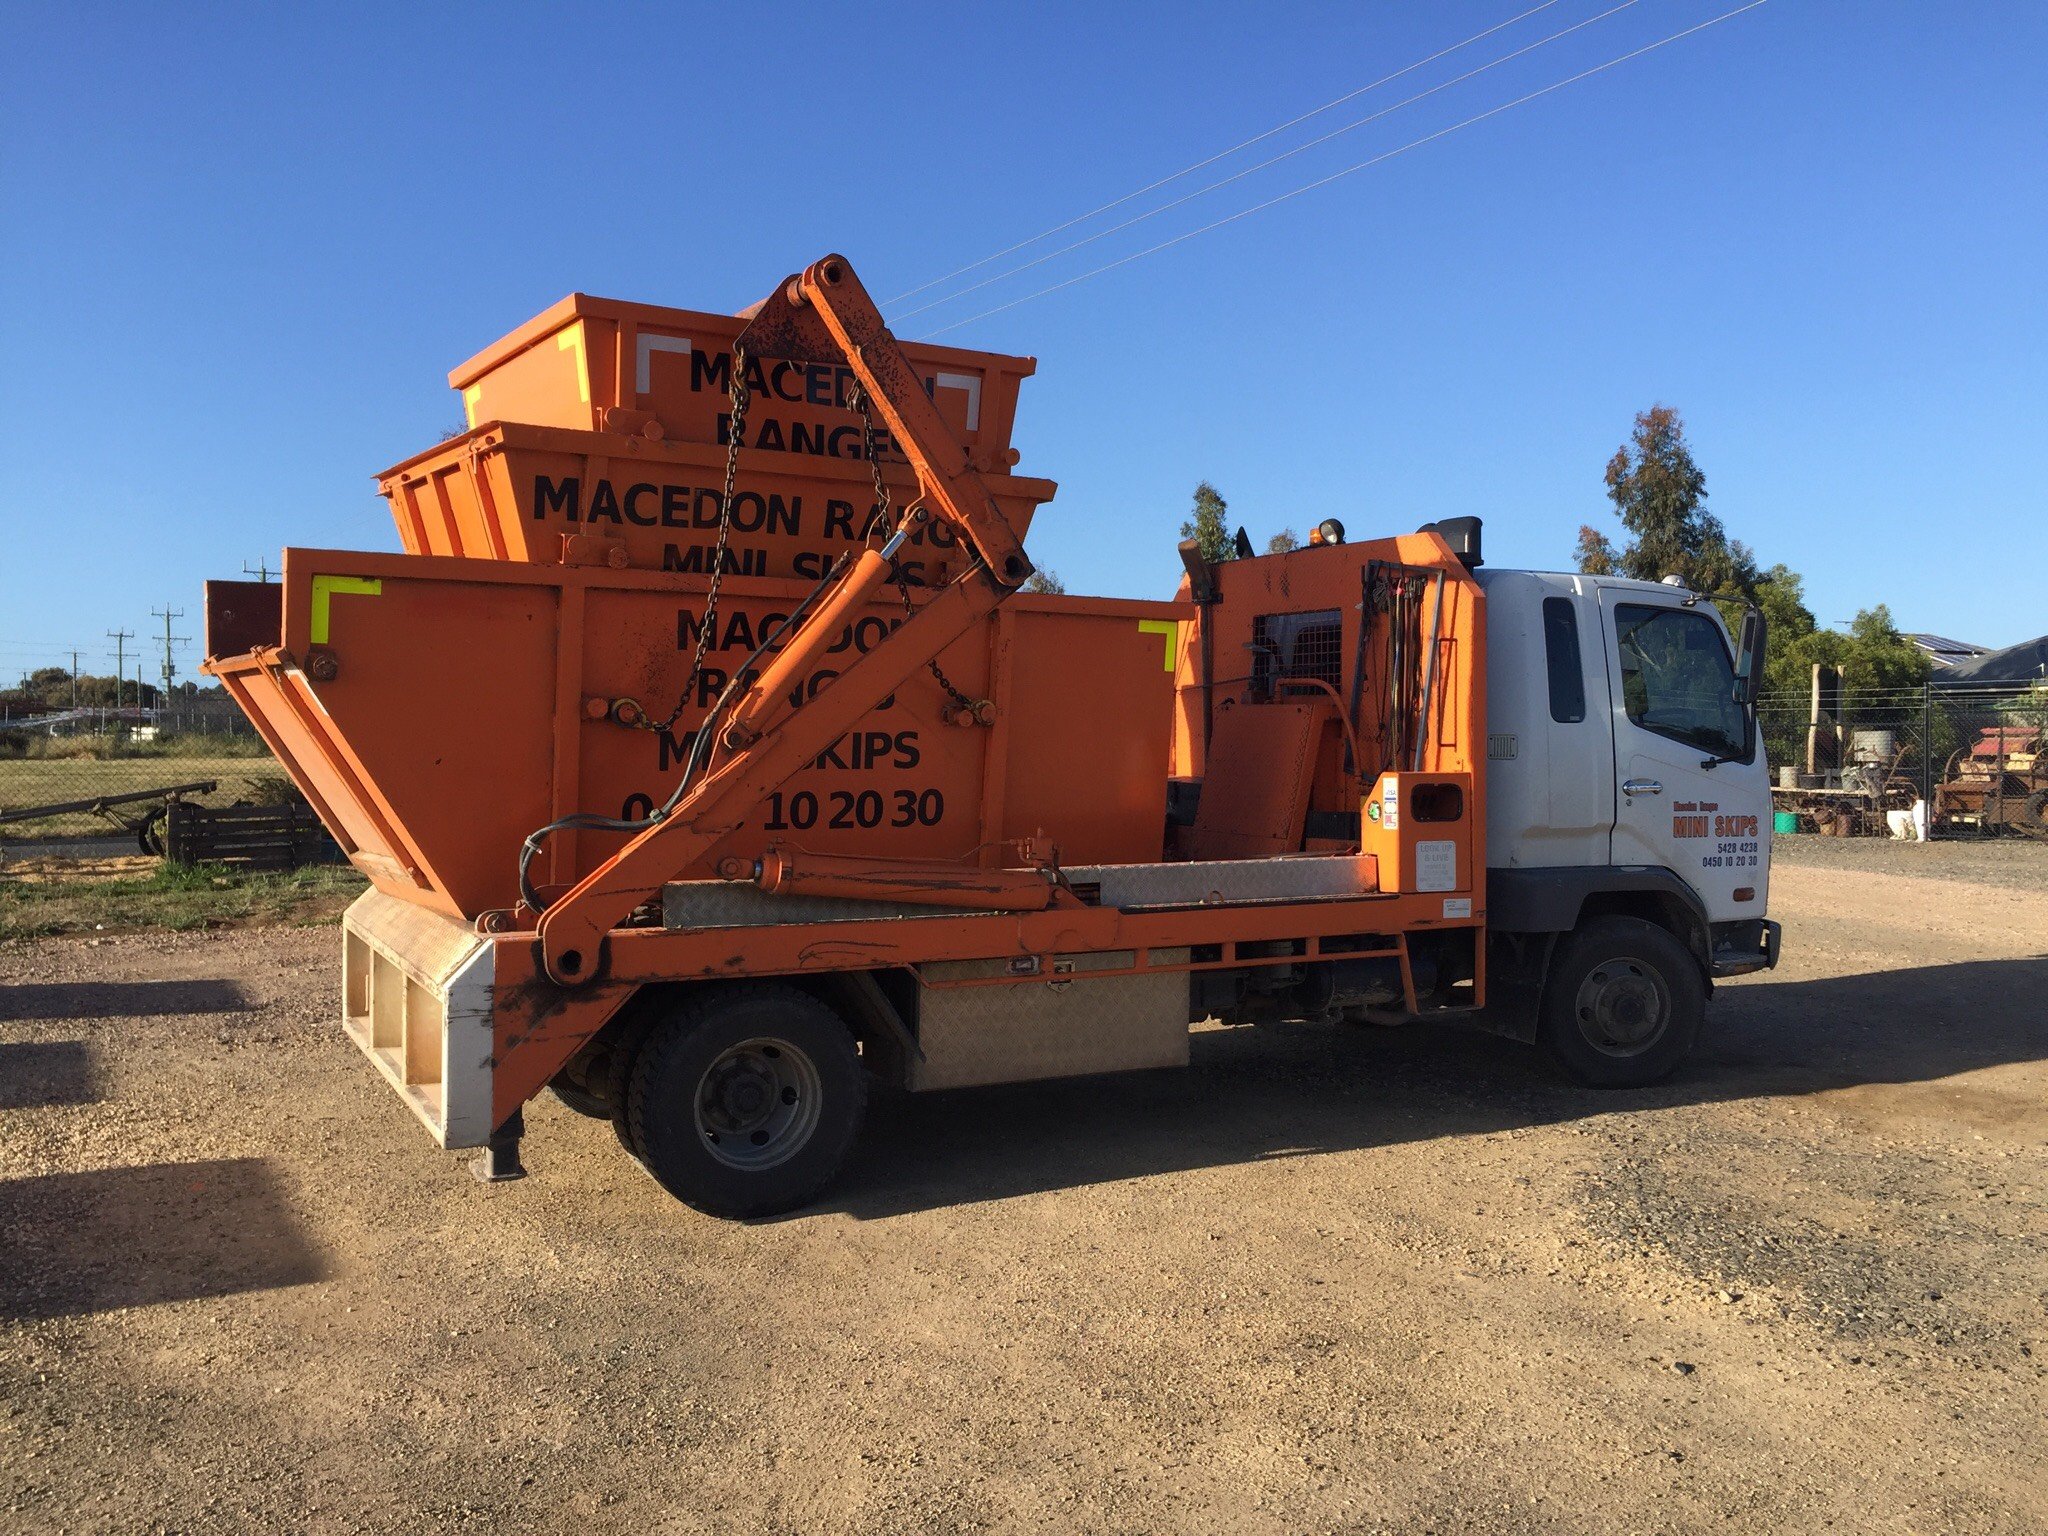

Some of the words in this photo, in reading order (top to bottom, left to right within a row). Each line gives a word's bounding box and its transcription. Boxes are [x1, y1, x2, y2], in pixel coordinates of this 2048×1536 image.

[716, 412, 908, 461] RANGE
[533, 474, 802, 537] MACEDON
[802, 730, 921, 771] KIPS
[763, 791, 819, 831] 10
[828, 790, 884, 830] 20
[891, 788, 945, 829] 30
[1672, 815, 1709, 838] MINI
[1715, 815, 1758, 837] SKIPS
[1702, 857, 1722, 867] 0450
[1725, 856, 1733, 867] 10
[1736, 856, 1746, 867] 20
[1748, 856, 1758, 866] 30
[1717, 843, 1737, 853] 5428
[1740, 842, 1758, 853] 4238
